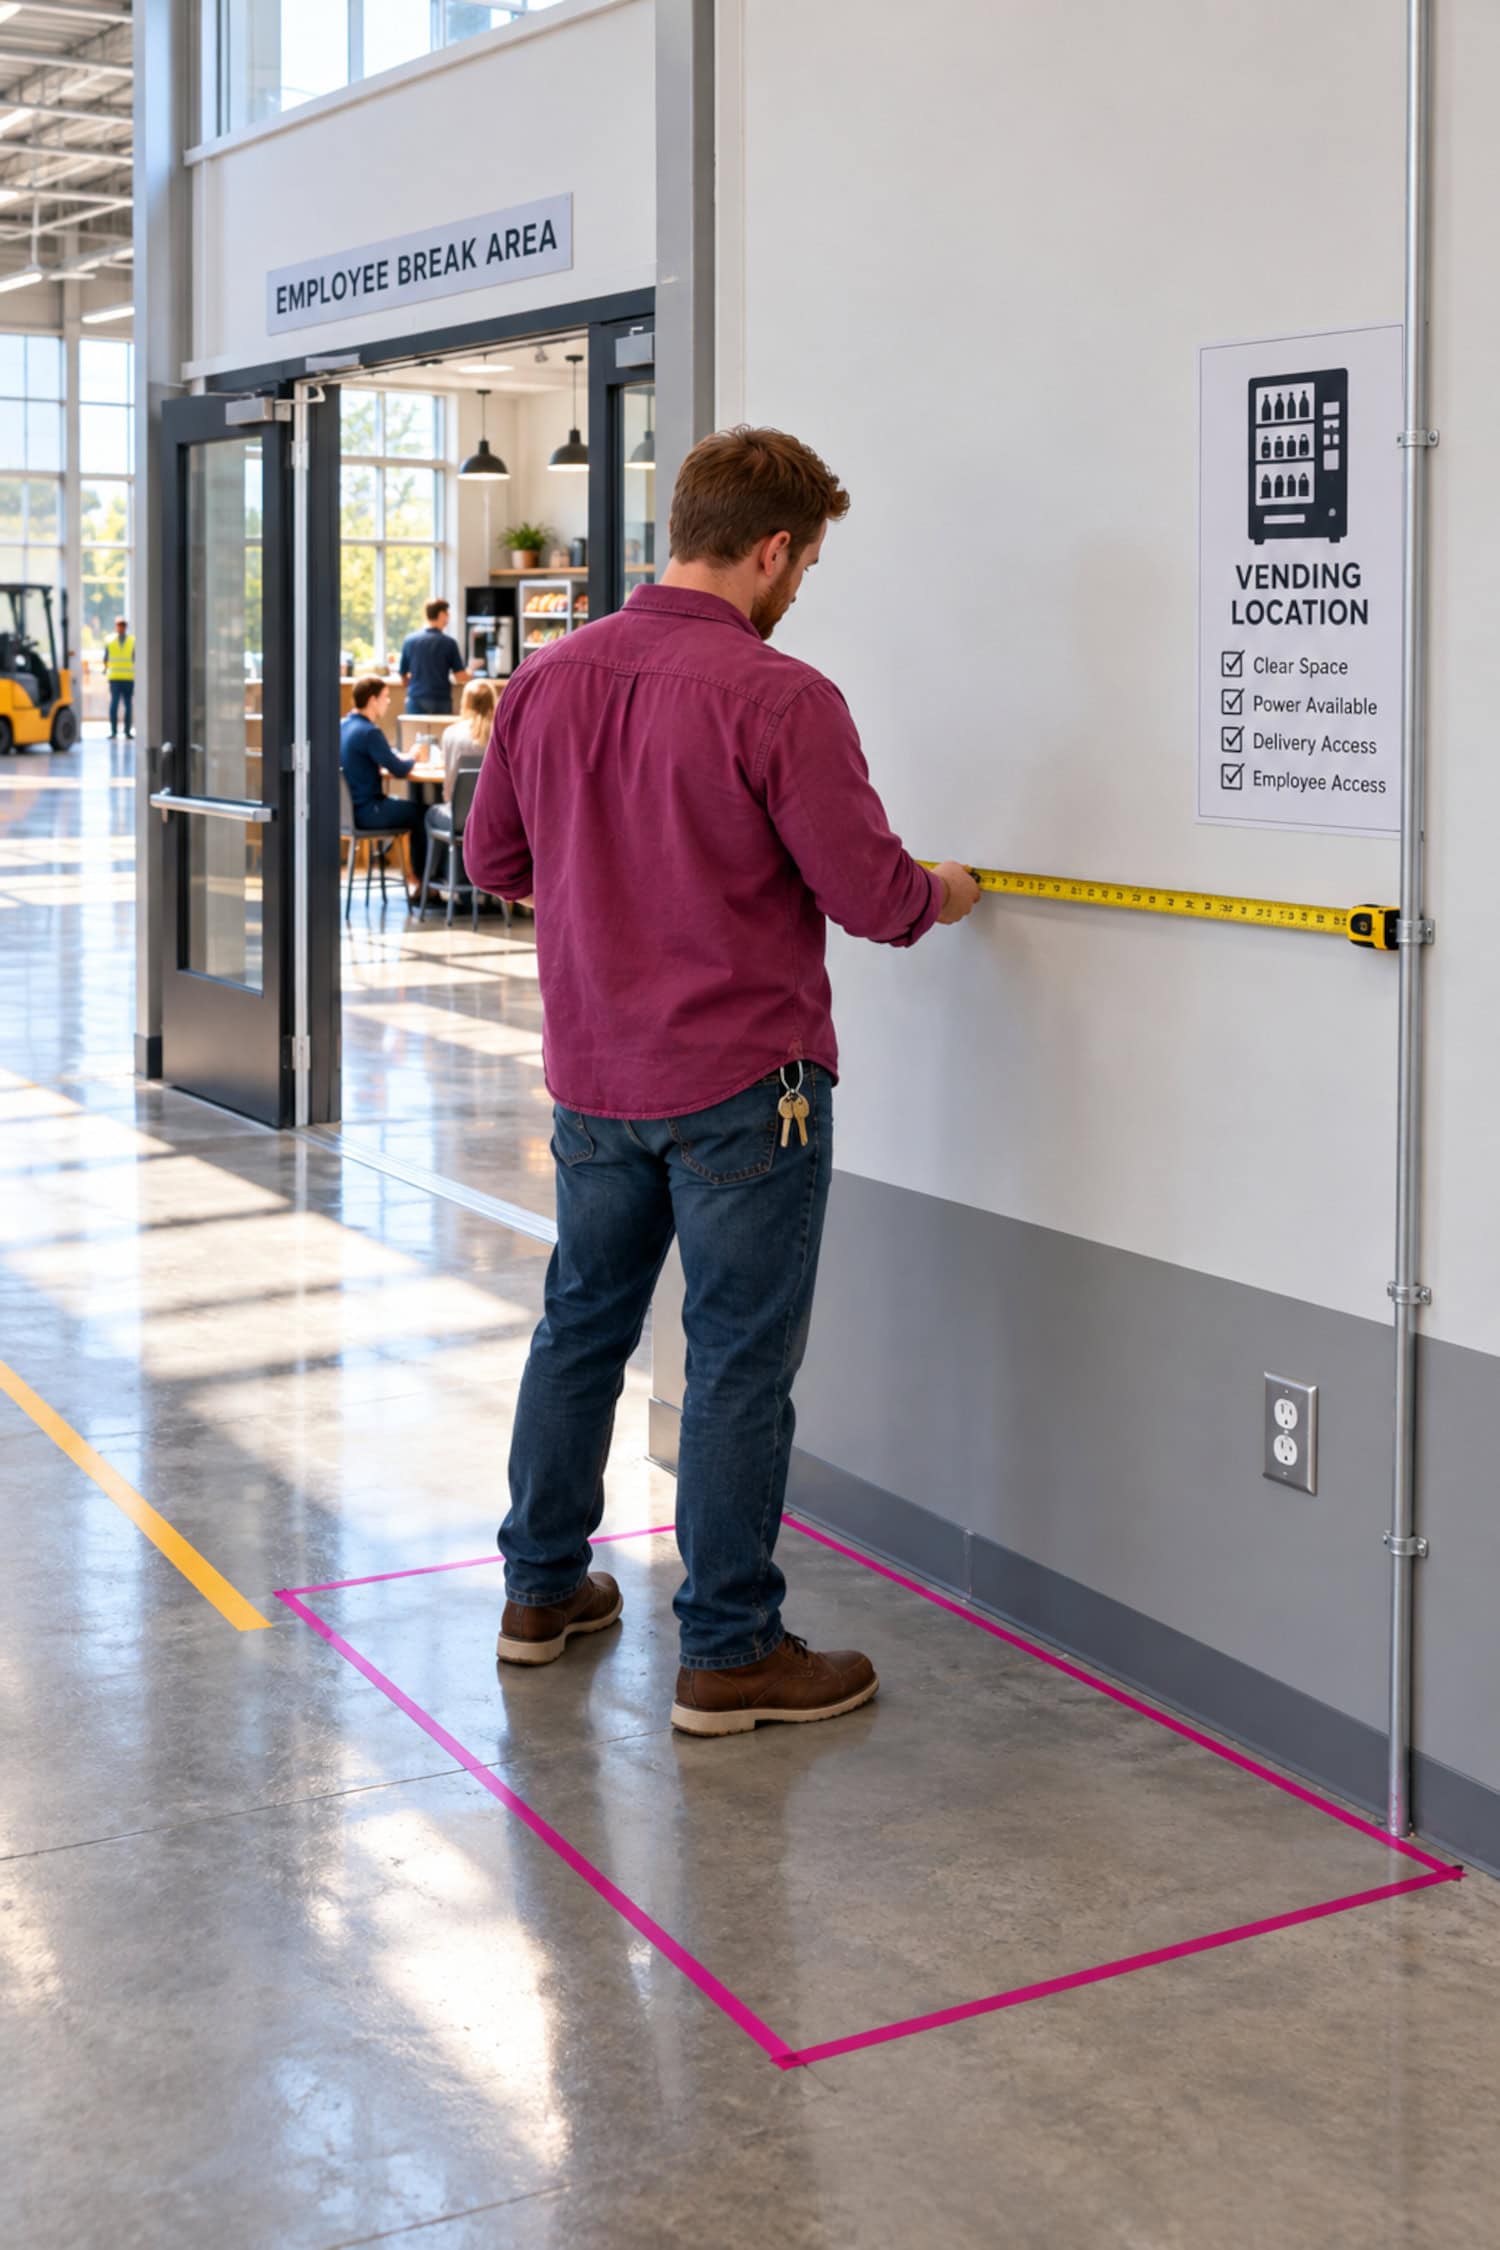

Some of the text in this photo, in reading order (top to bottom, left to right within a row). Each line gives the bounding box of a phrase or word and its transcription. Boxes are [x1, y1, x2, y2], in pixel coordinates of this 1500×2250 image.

[276, 219, 558, 315] EMPLOYEE BREAK AREA
[1235, 562, 1362, 590] VENDING
[1231, 599, 1369, 626] LOCATION
[1253, 656, 1349, 679] Clear Space
[1253, 694, 1378, 716] Power Available
[1253, 732, 1378, 757] Delivery Access
[1253, 769, 1387, 794] Employee Access
